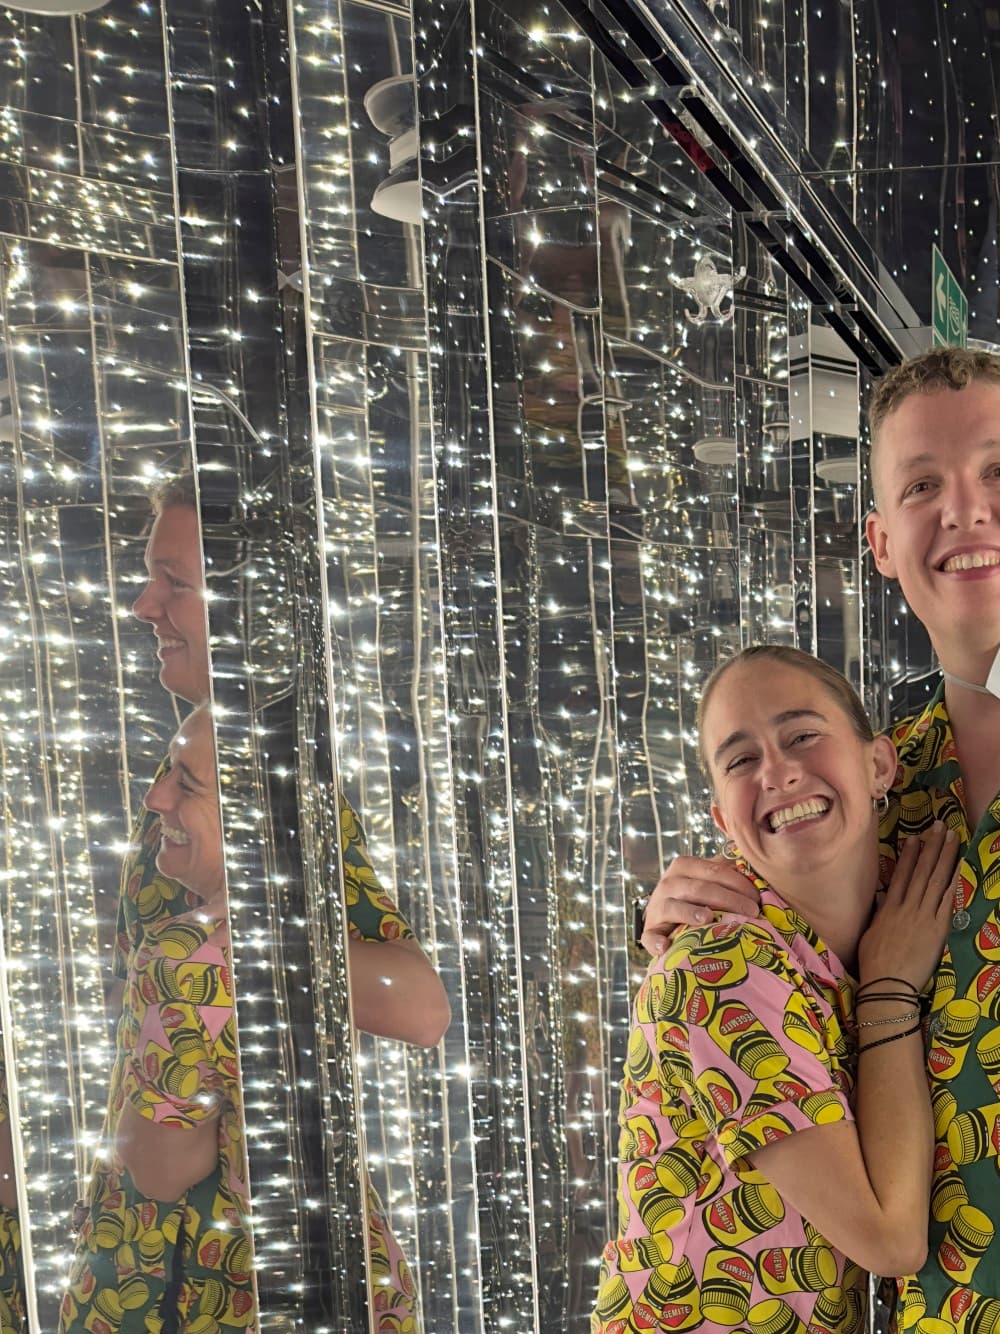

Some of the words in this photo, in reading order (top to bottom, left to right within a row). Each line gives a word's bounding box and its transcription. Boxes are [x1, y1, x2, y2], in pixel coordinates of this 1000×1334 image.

[693, 961, 729, 973] VEGEMITE
[719, 1010, 754, 1034] VEGEMITE
[714, 1198, 735, 1232] VEGEMITE
[719, 1261, 753, 1281] VEGEMITE
